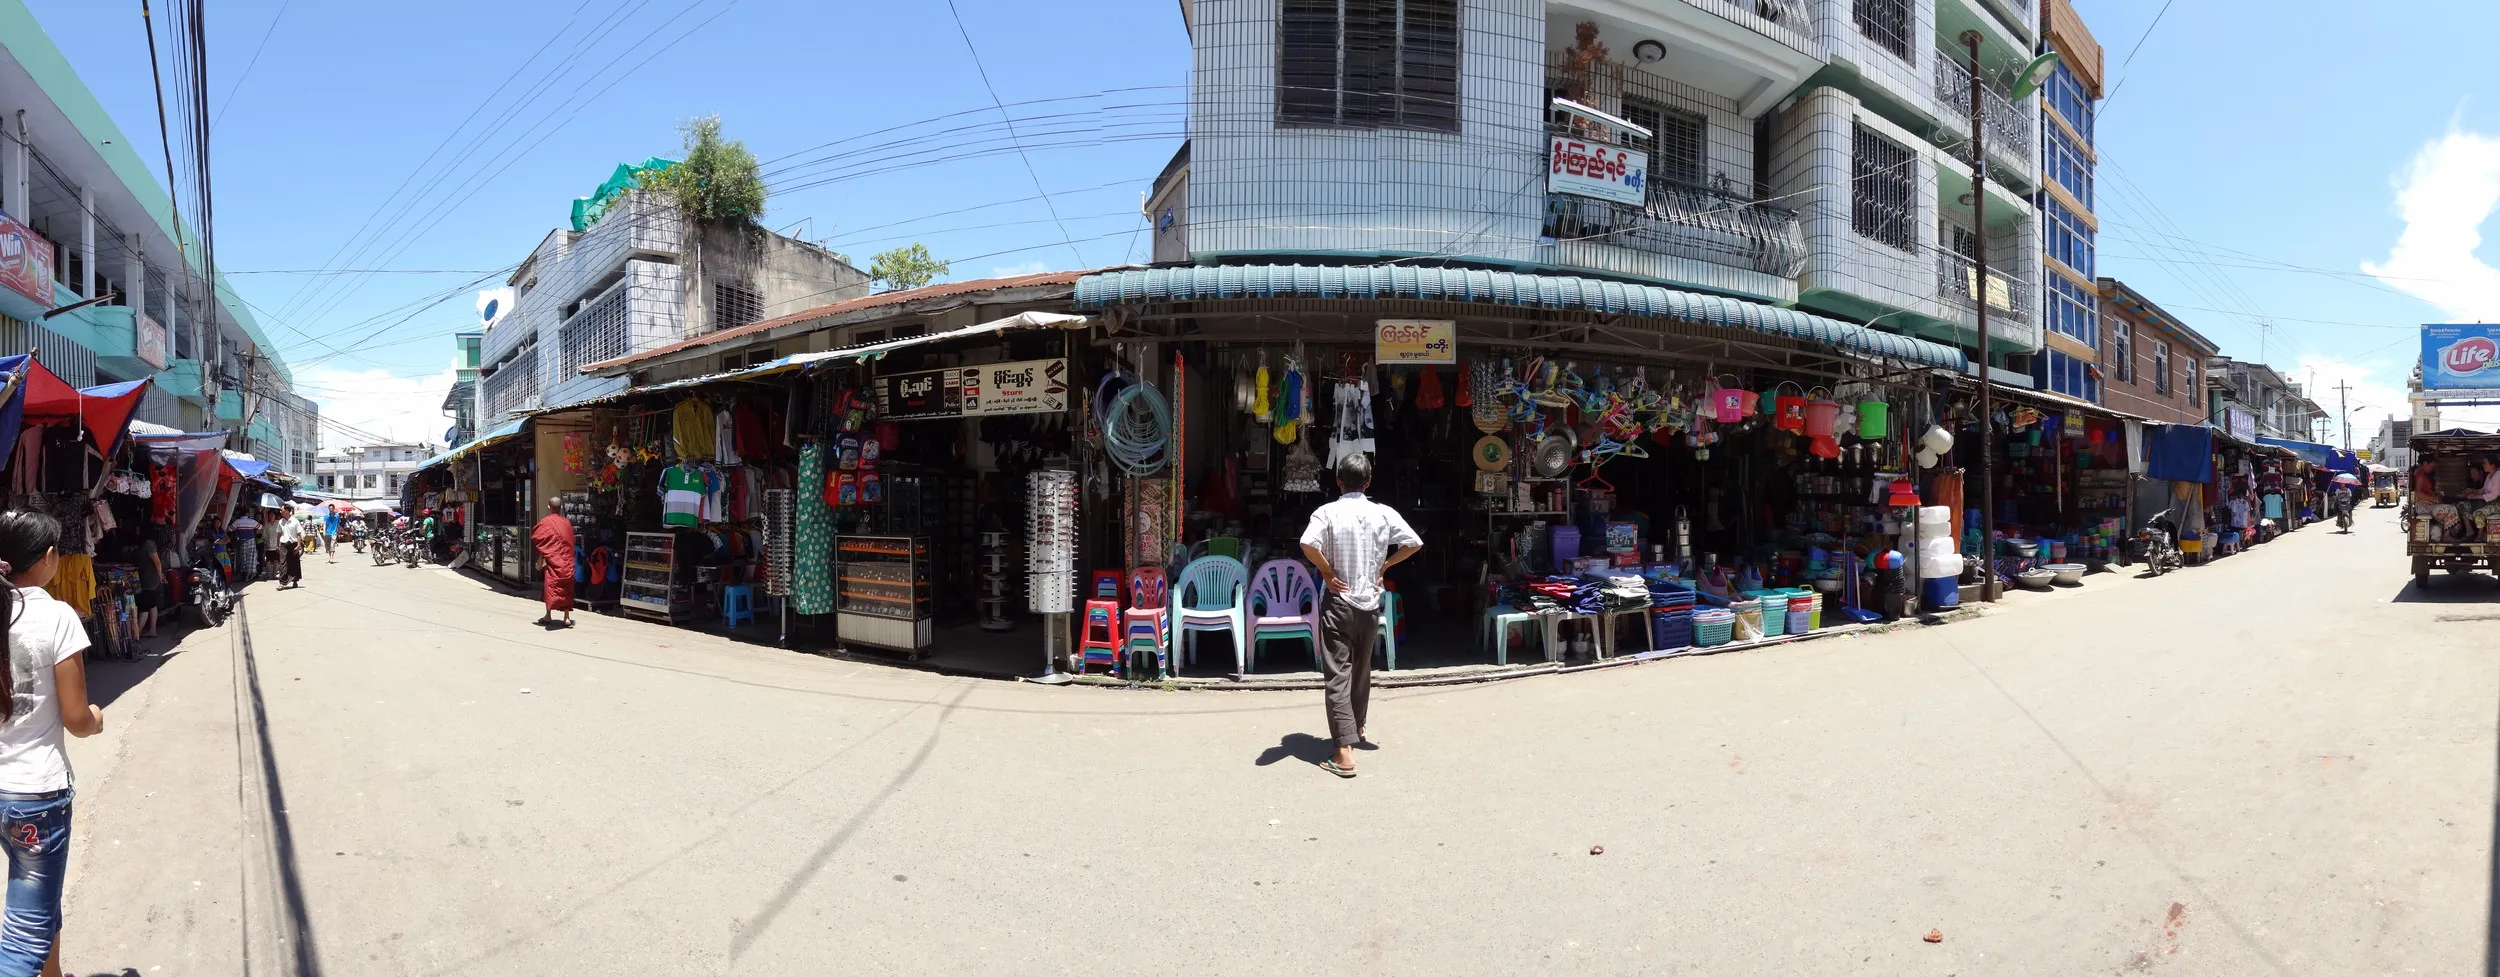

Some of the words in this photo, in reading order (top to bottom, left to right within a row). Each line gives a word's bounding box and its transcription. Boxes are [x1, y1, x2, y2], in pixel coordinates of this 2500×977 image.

[0, 233, 21, 257] Win
[2450, 346, 2490, 365] Life
[22, 824, 39, 844] 2
